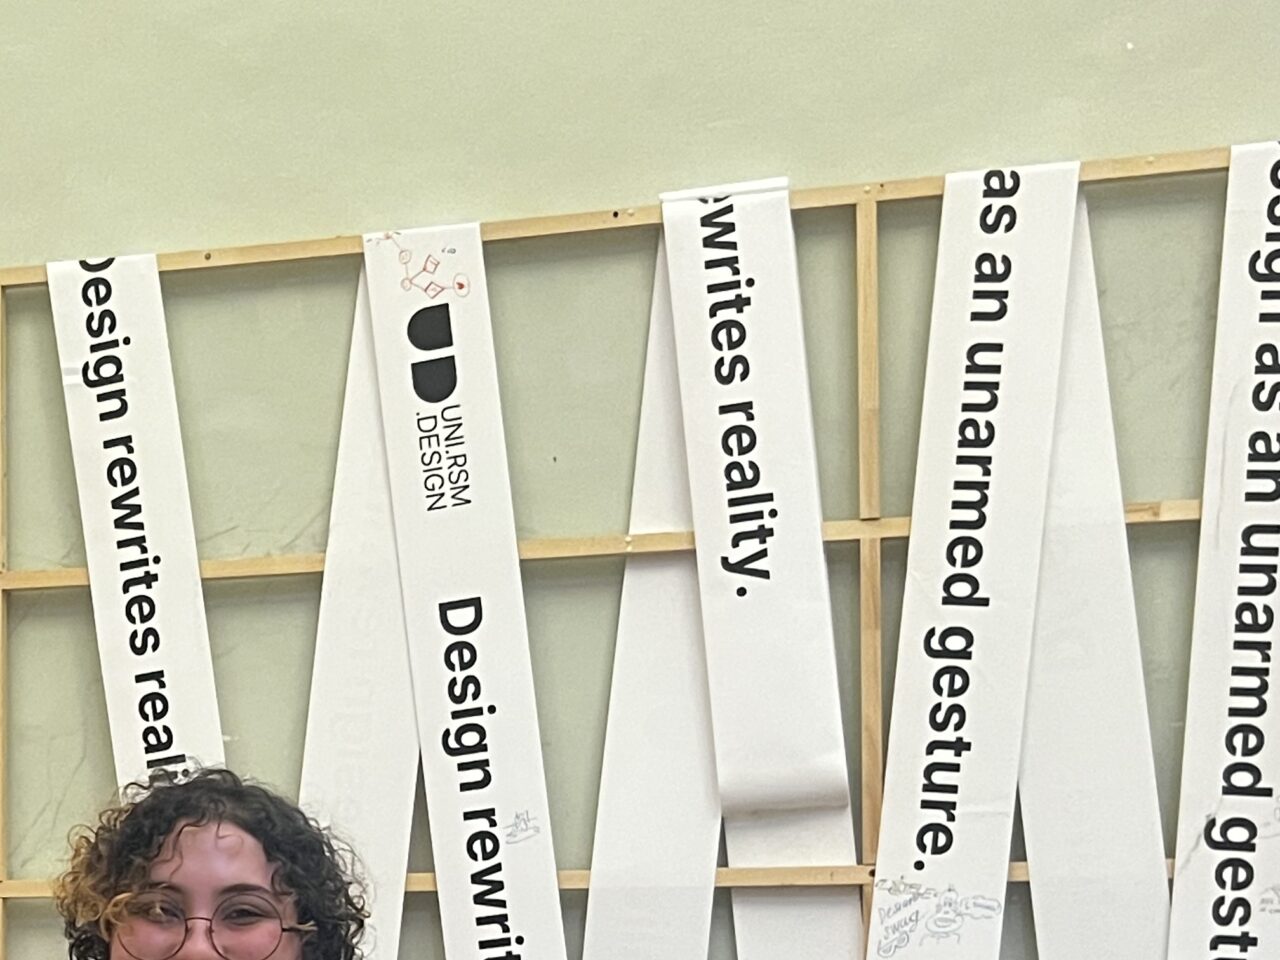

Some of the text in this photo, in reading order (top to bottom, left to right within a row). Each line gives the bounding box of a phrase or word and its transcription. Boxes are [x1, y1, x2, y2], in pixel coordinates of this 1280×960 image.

[103, 435, 161, 657] rewrites
[416, 411, 447, 512] .DESIGN
[440, 403, 472, 508] UNI.RSM
[718, 400, 778, 598] reality.
[913, 169, 1021, 871] as an unarmed gesture.
[439, 596, 496, 792] Design
[1222, 523, 1280, 797] unarmed
